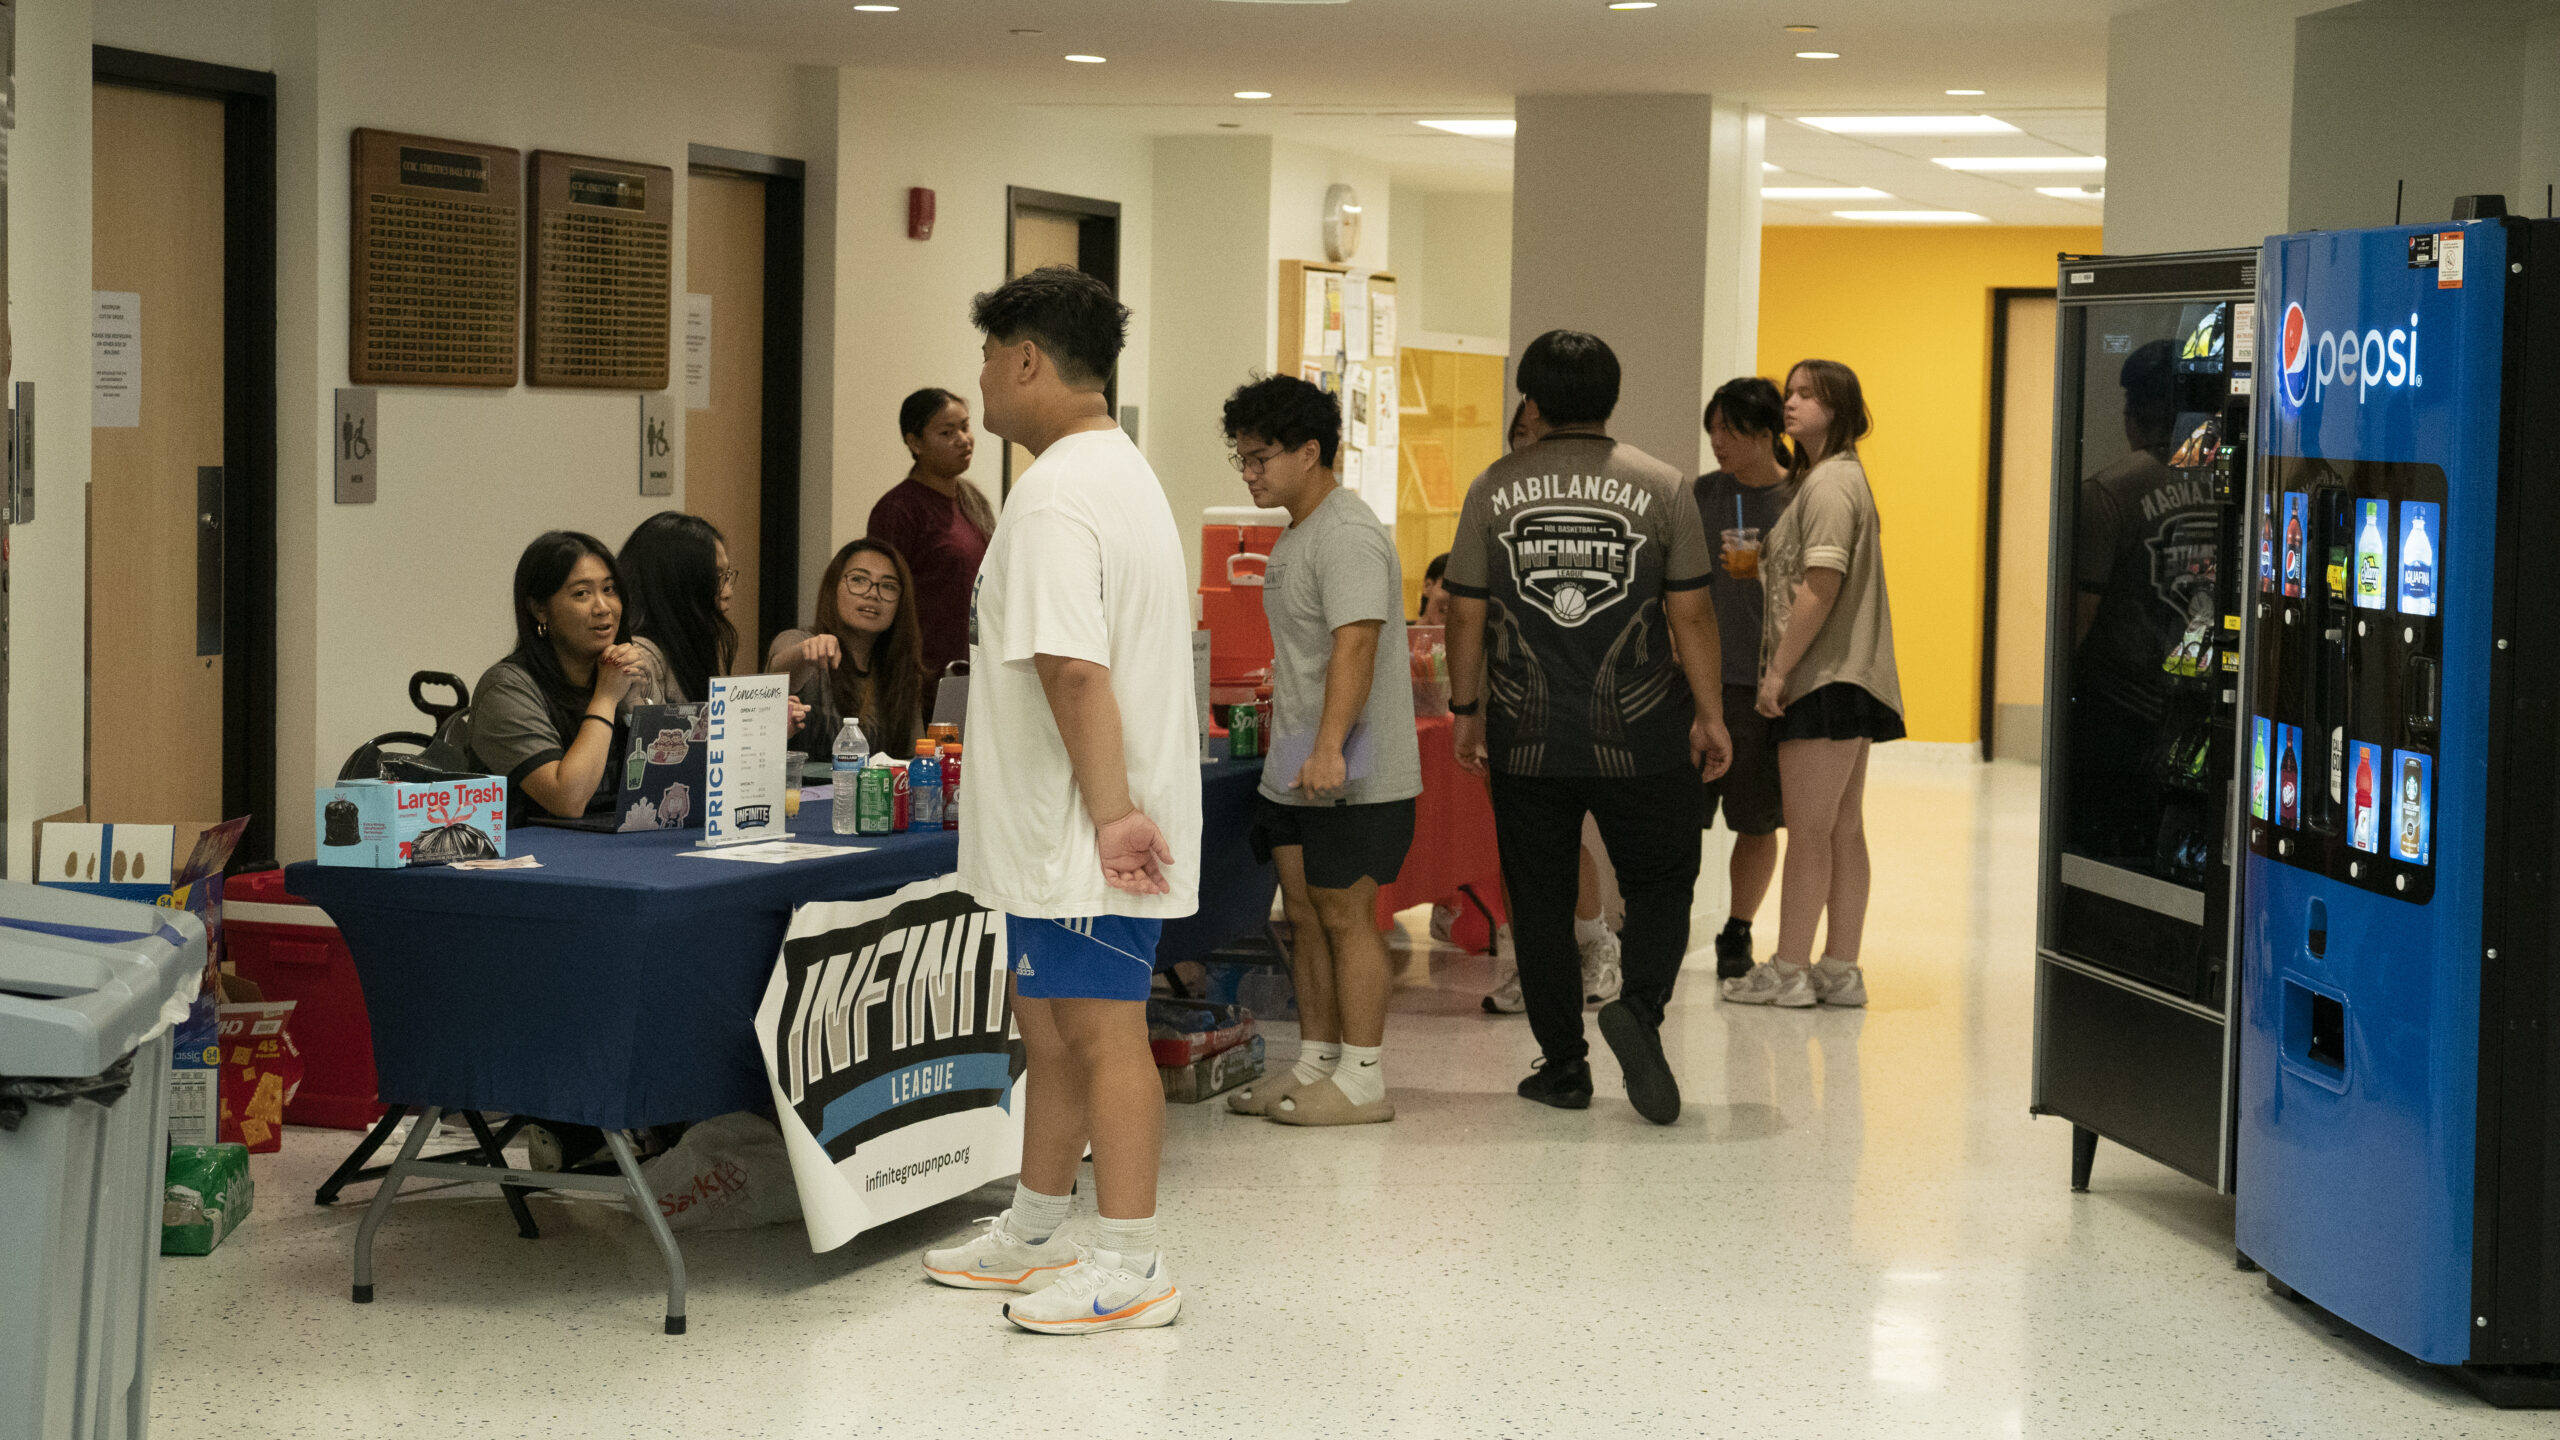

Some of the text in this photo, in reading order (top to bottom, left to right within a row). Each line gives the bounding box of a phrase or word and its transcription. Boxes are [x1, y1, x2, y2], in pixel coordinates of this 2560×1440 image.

[2315, 313, 2418, 404] pepsi
[1491, 474, 1652, 517] MABILANGAN
[1557, 525, 1598, 534] BASKETBALL
[1517, 539, 1626, 573] INFINITE
[1557, 570, 1584, 578] LEAGUE
[729, 685, 783, 702] Concessions
[709, 681, 726, 836] PRICE LIST
[398, 782, 503, 811] Large Trash
[736, 807, 769, 823] INFINITE
[160, 897, 172, 907] 54
[1016, 967, 1035, 977] adidas
[788, 910, 1022, 1107] INFINIT
[206, 1049, 217, 1058] 54
[257, 1040, 278, 1052] 45
[891, 1062, 954, 1105] LEAGUE
[865, 1145, 970, 1192] infinitegroupnpo.org
